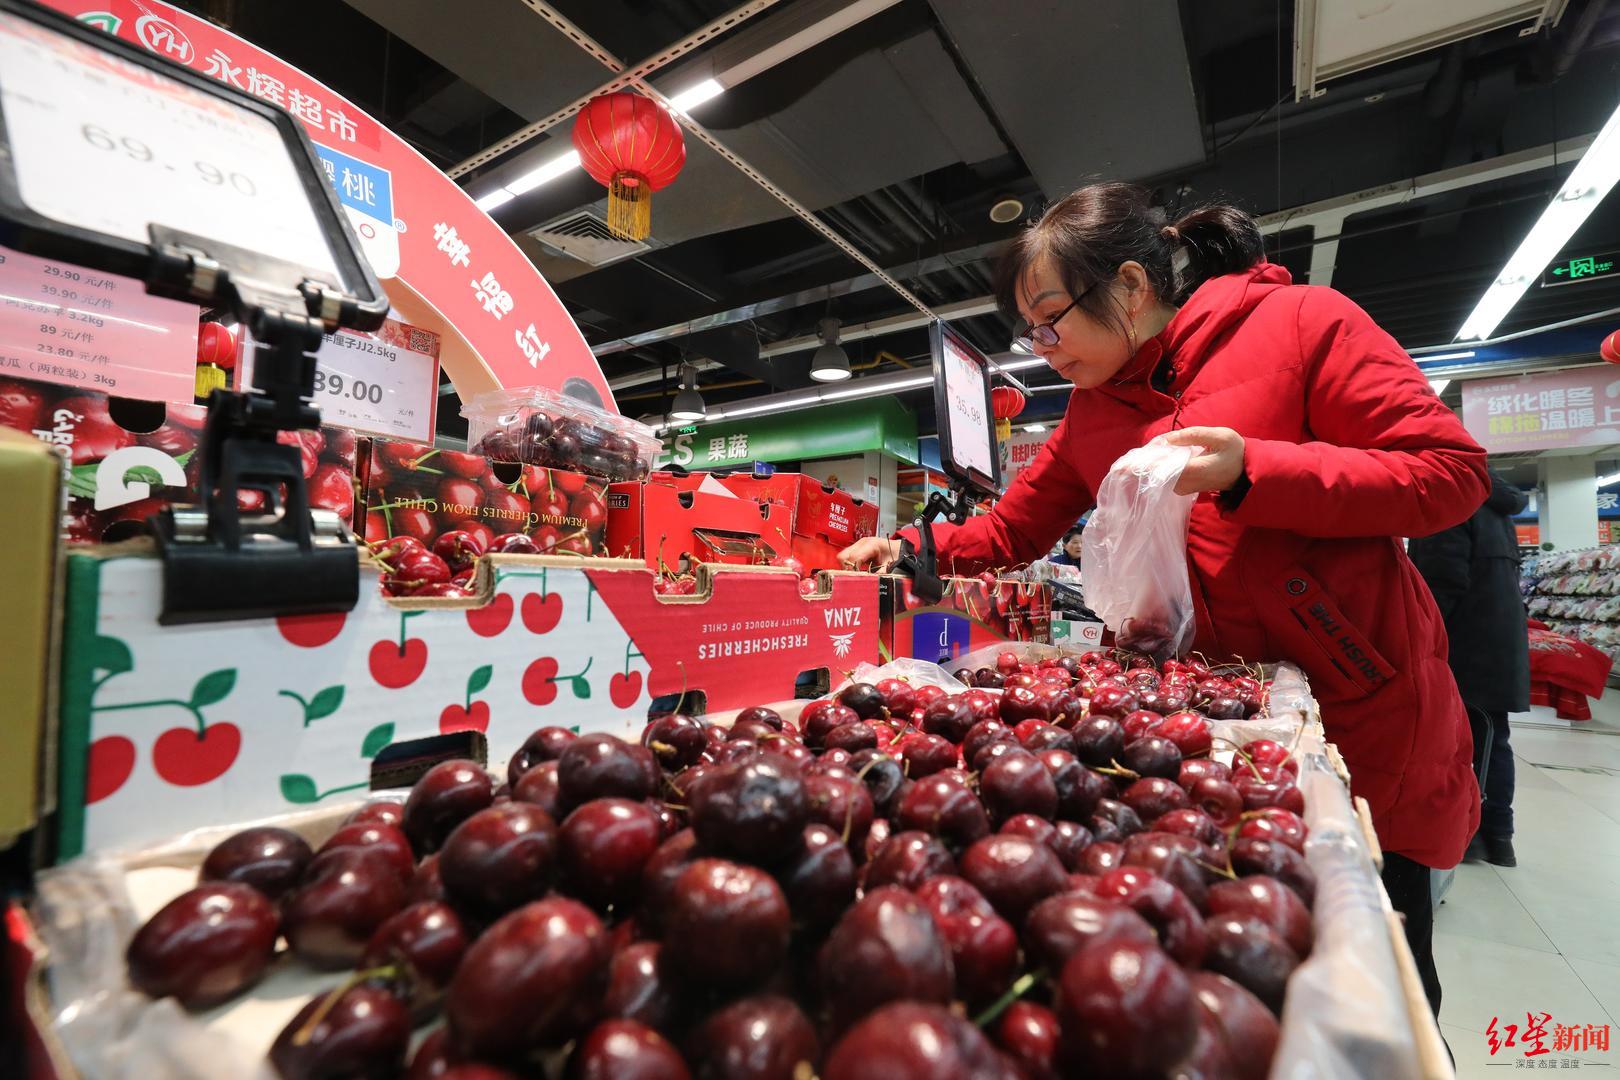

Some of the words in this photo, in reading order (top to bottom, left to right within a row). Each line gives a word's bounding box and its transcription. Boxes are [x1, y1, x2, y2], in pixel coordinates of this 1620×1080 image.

[148, 24, 190, 60] YH
[203, 48, 359, 143] 永辉超市
[81, 123, 258, 198] 69.90
[43, 265, 81, 281] 29.90
[41, 284, 78, 300] 39.90
[40, 324, 57, 335] 89
[37, 343, 74, 358] 23.80
[707, 433, 749, 462] 果蔬
[394, 496, 438, 513] CHILE
[442, 502, 479, 517] FROM
[483, 507, 539, 524] CHERRIES
[542, 513, 588, 528] PREMIUM
[745, 620, 779, 630] PRODUCE
[781, 615, 809, 627] QUALITY
[823, 607, 862, 629] ZANA
[702, 623, 728, 633] CHILE
[731, 622, 742, 631] OF
[698, 633, 809, 660] FRESHCHERRIES
